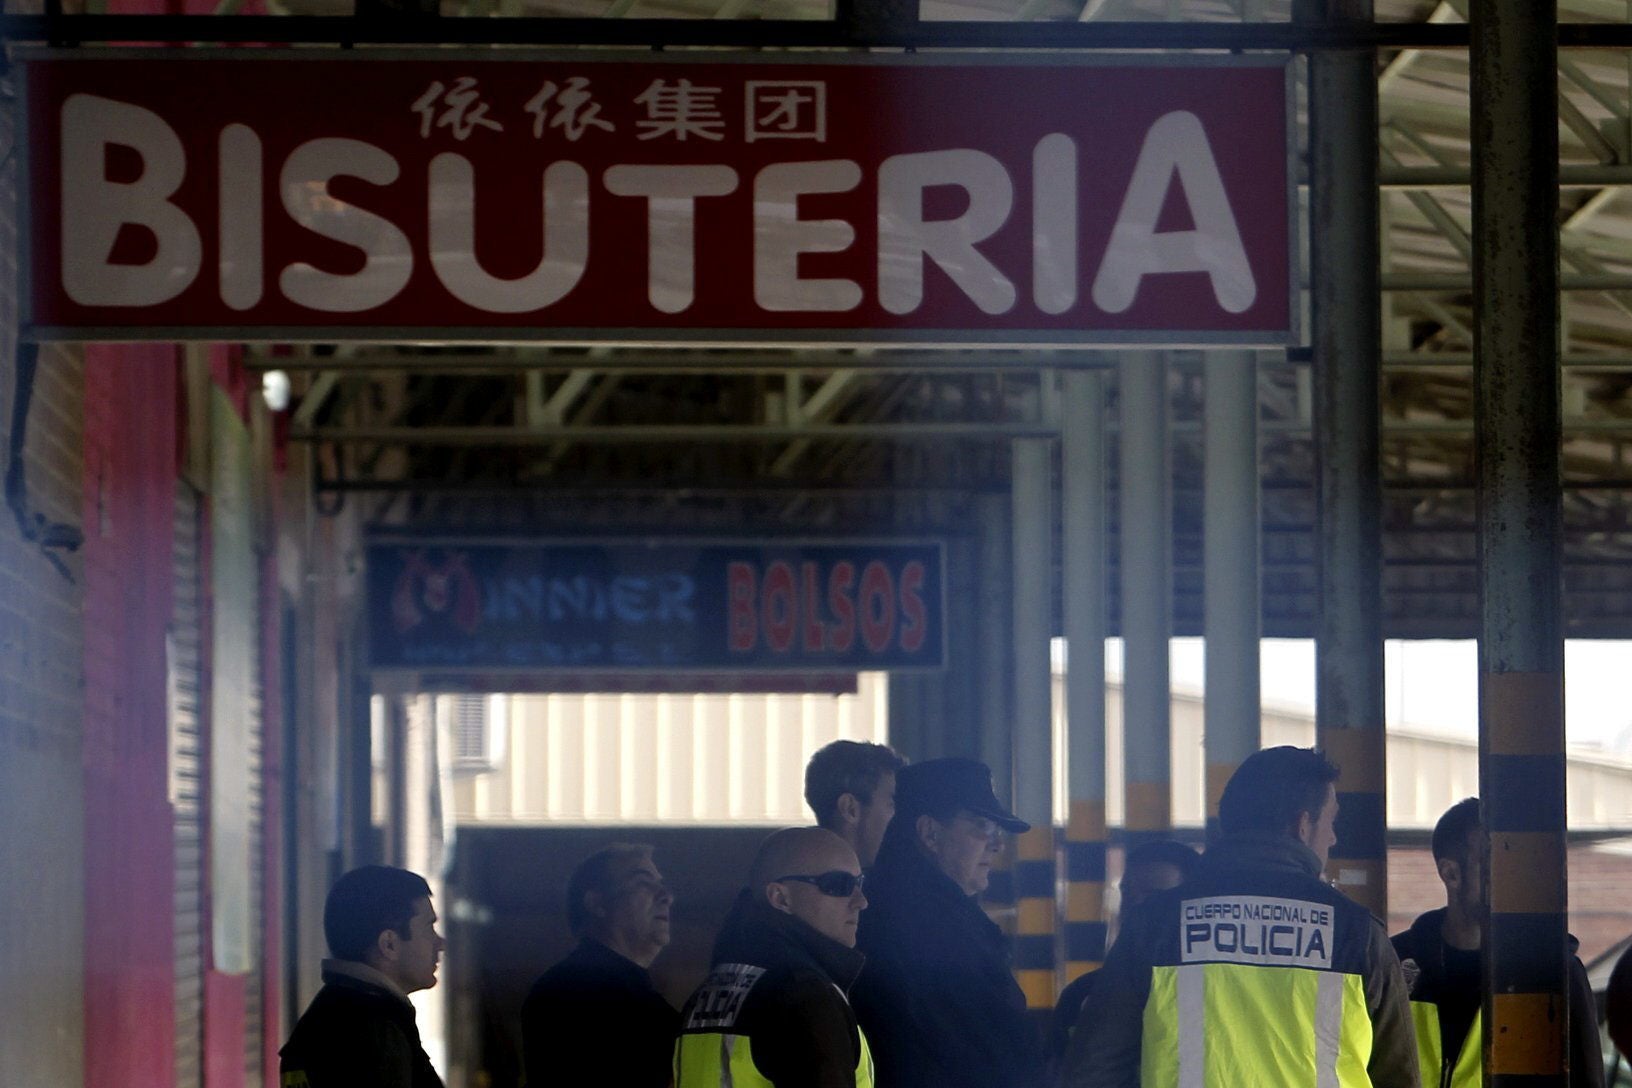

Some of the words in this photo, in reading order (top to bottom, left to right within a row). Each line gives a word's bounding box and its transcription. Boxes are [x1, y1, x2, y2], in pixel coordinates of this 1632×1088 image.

[411, 77, 828, 144] 依依集团
[60, 93, 1257, 316] BISUTERIA
[727, 561, 927, 653] BOLSOS
[1185, 903, 1241, 920] CUERPO
[1243, 904, 1307, 924] NACIONAL
[1310, 909, 1329, 926] DE
[1186, 923, 1327, 960] POLICIA
